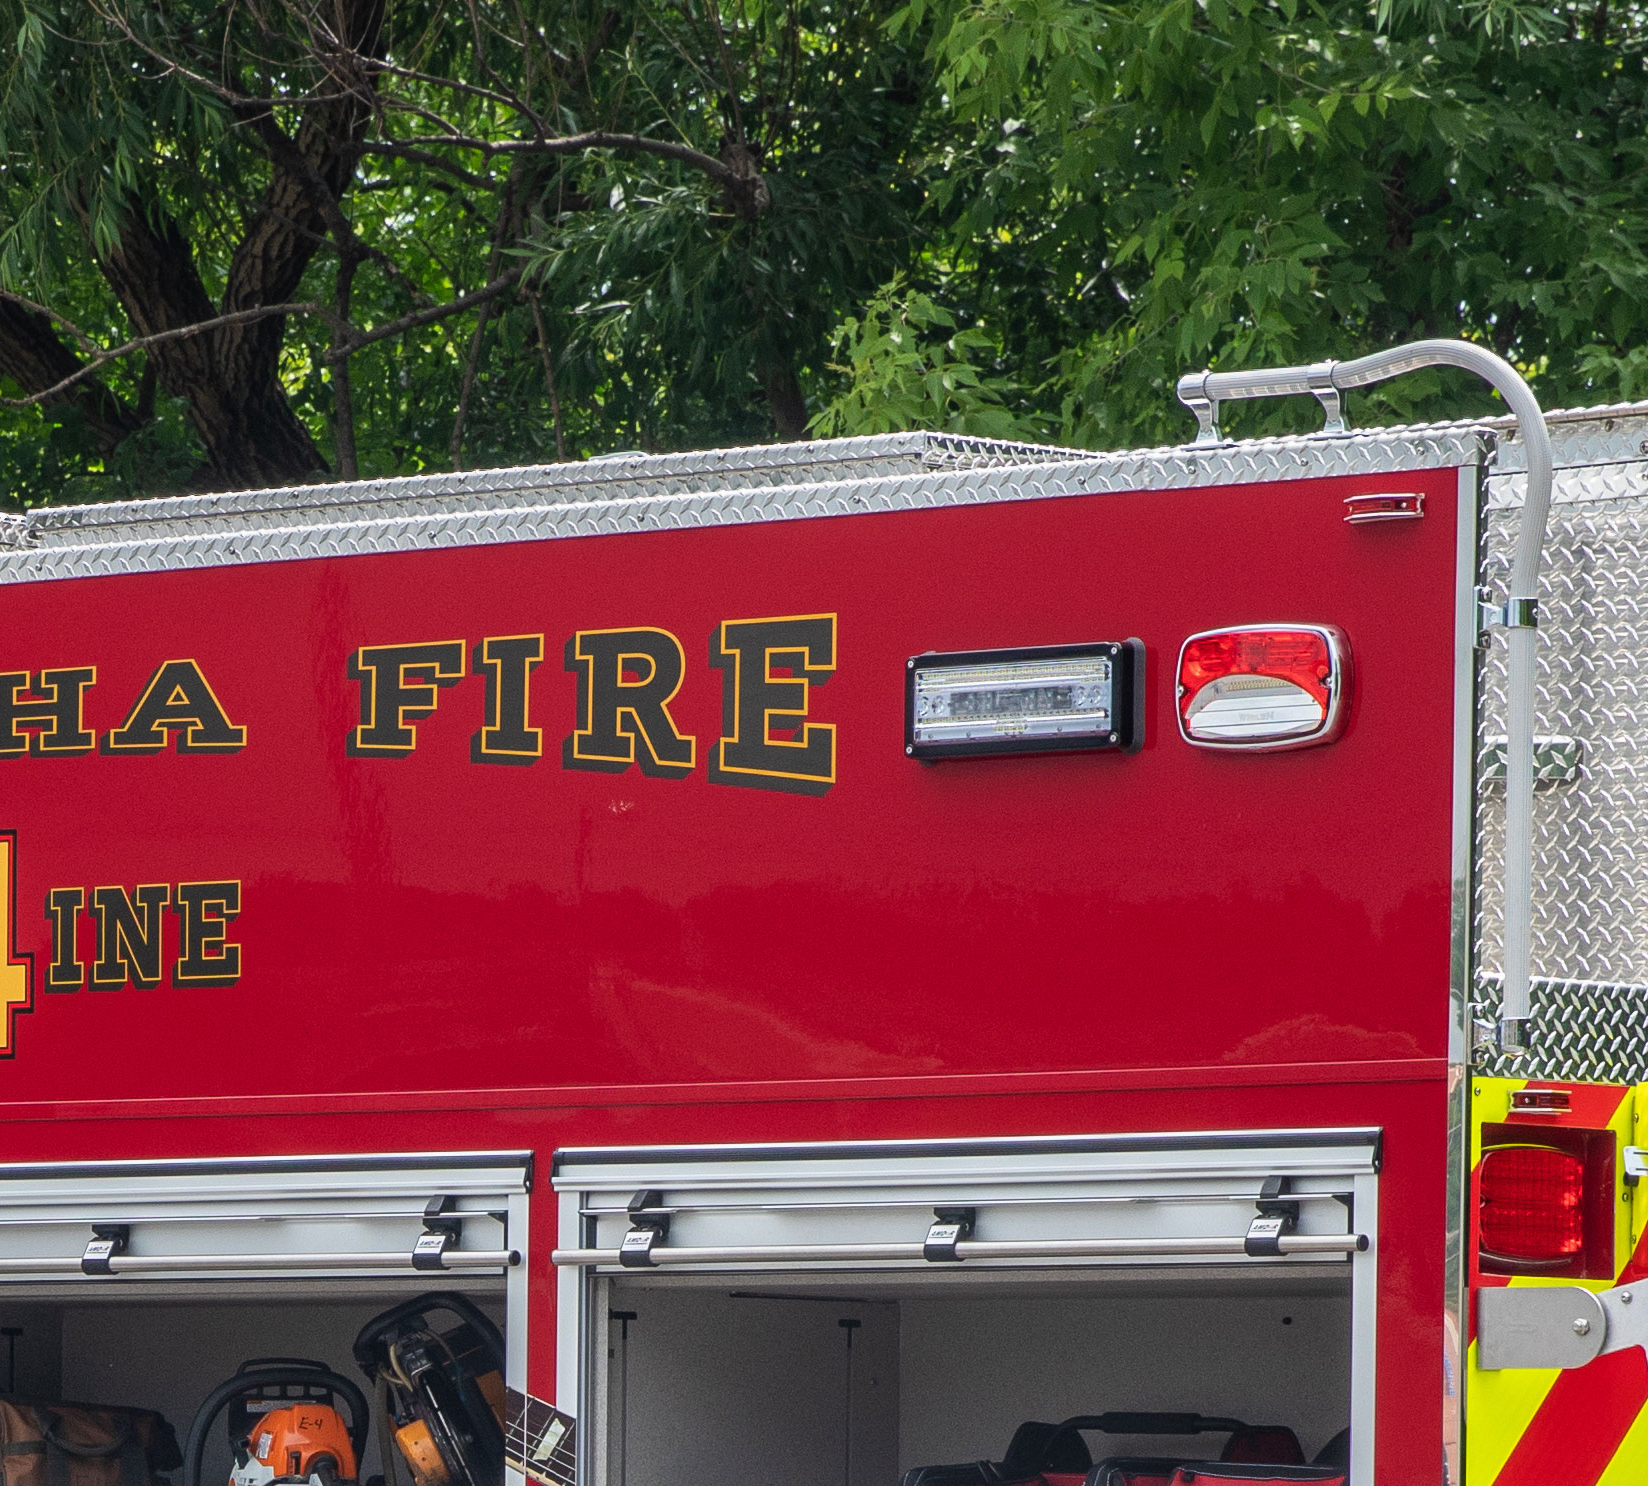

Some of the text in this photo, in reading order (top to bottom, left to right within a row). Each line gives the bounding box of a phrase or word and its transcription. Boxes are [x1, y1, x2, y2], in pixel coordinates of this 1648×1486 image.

[346, 612, 838, 798] FIRE
[44, 879, 242, 994] INE
[298, 1417, 323, 1430] E-4
